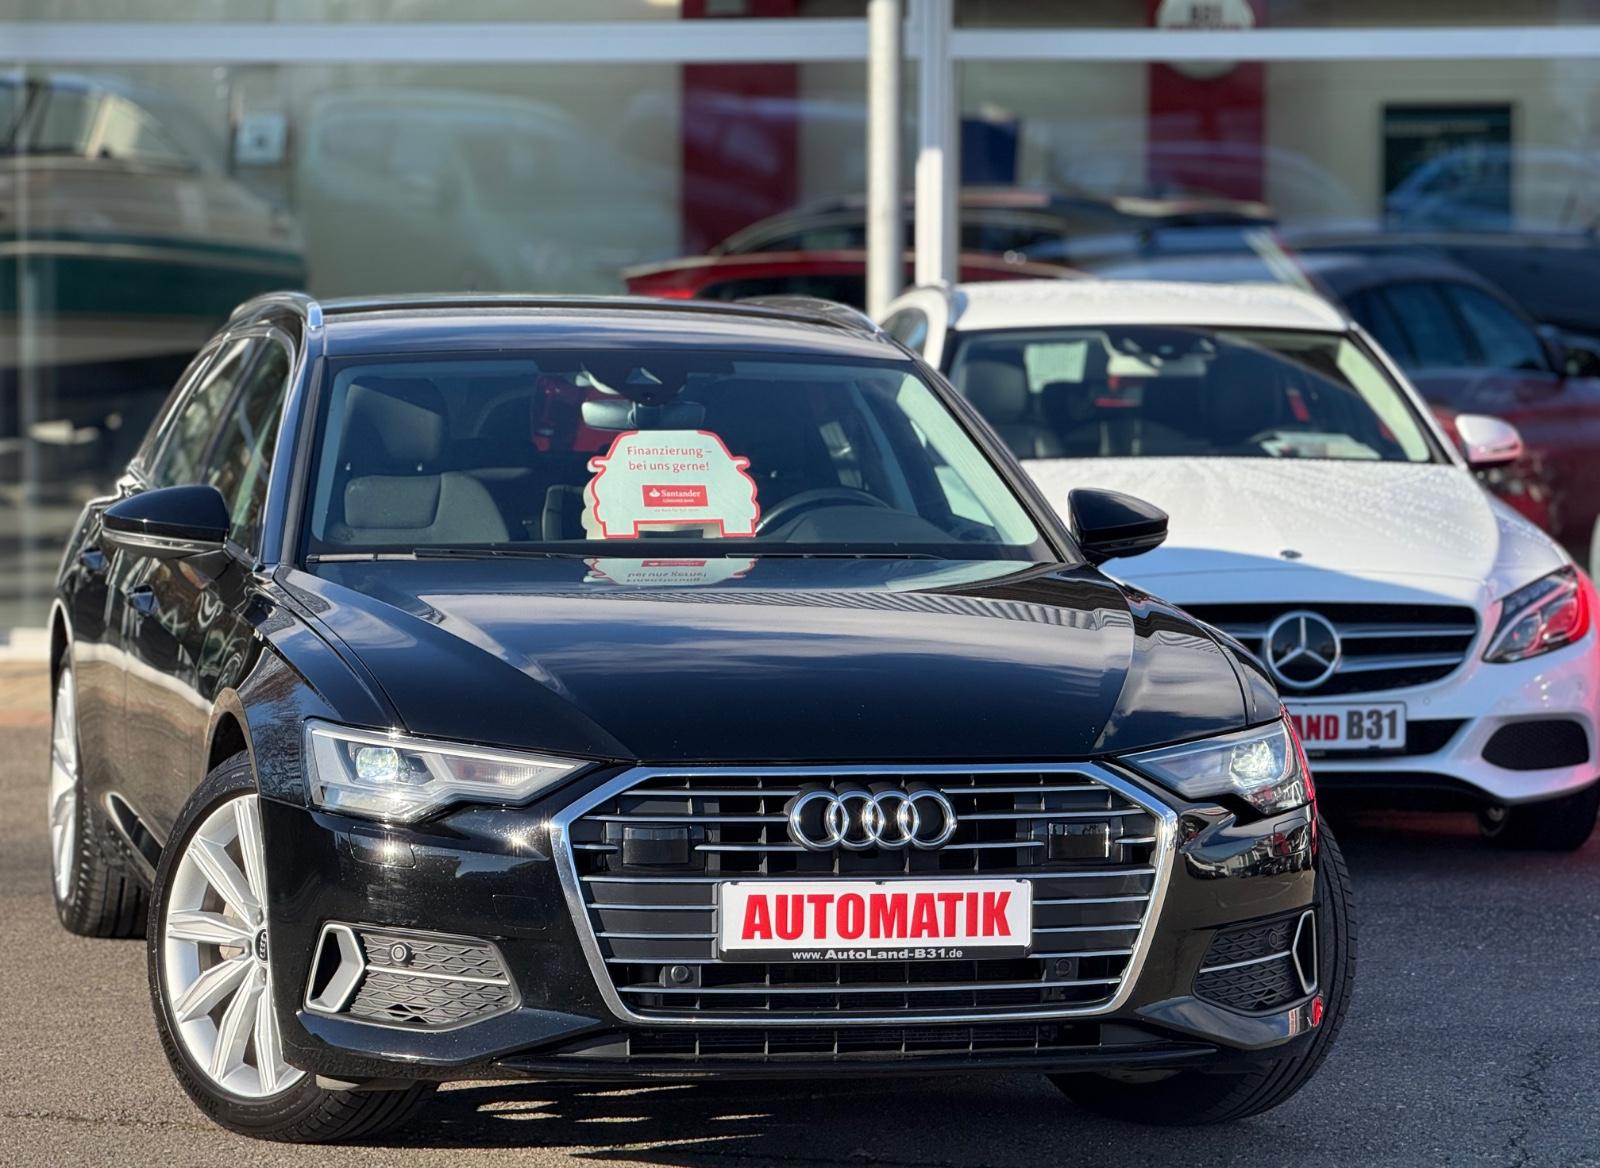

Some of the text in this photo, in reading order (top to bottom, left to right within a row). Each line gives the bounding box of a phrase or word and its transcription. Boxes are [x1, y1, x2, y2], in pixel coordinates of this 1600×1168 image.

[626, 446, 704, 459] Finanzierung
[628, 461, 710, 473] bei uns gerne!
[660, 488, 702, 498] Santander
[1346, 709, 1397, 740] B31
[741, 891, 1012, 940] AUTOMATIK
[791, 948, 963, 960] www.AutoLand-B31.de
